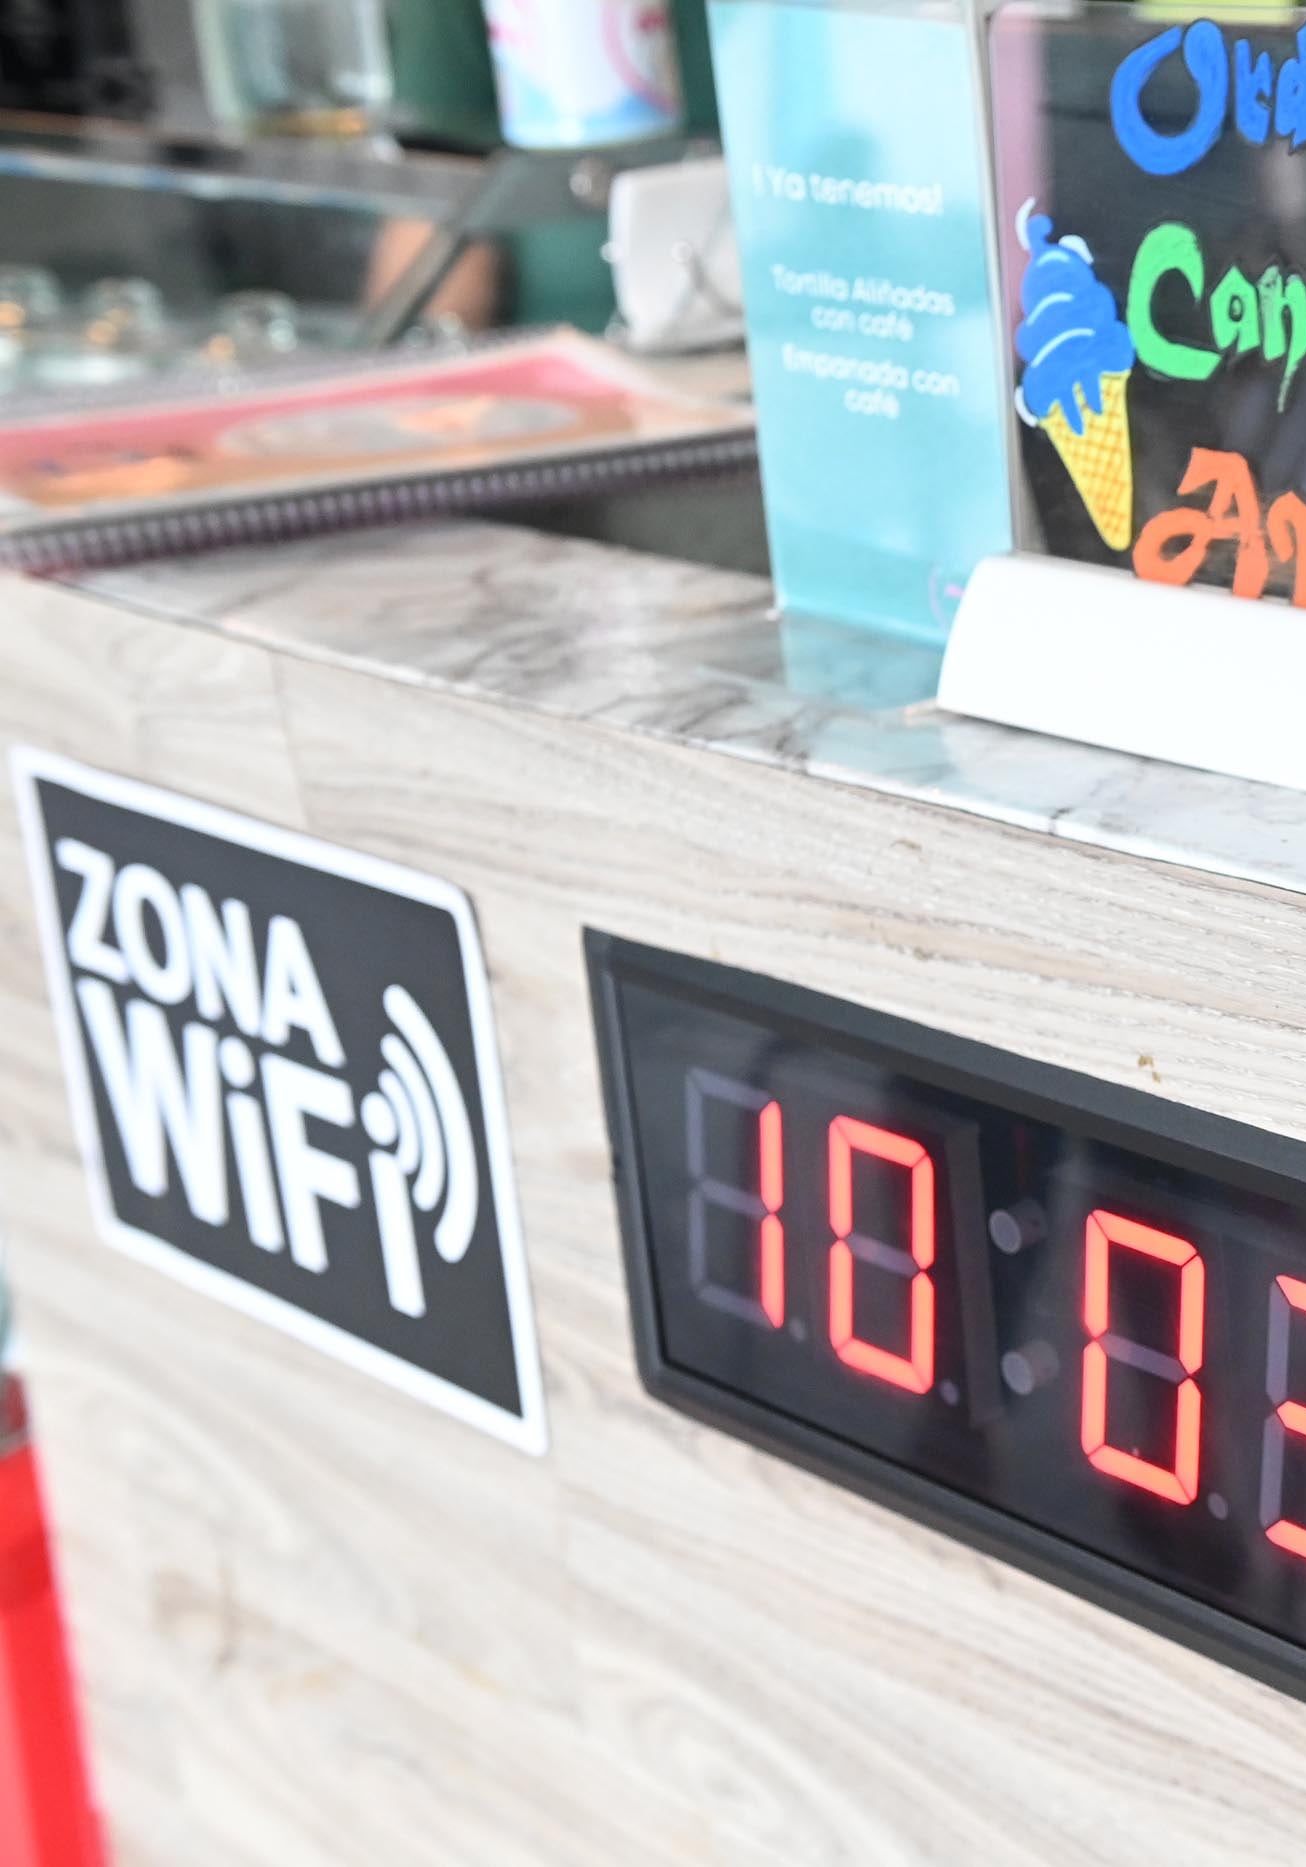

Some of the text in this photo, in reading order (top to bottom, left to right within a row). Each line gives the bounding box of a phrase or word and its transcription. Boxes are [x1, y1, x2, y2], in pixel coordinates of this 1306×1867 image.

[772, 265, 847, 299] Tortilla
[811, 306, 854, 331] con
[783, 344, 959, 395] Empanada con
[55, 837, 346, 1068] ZONA
